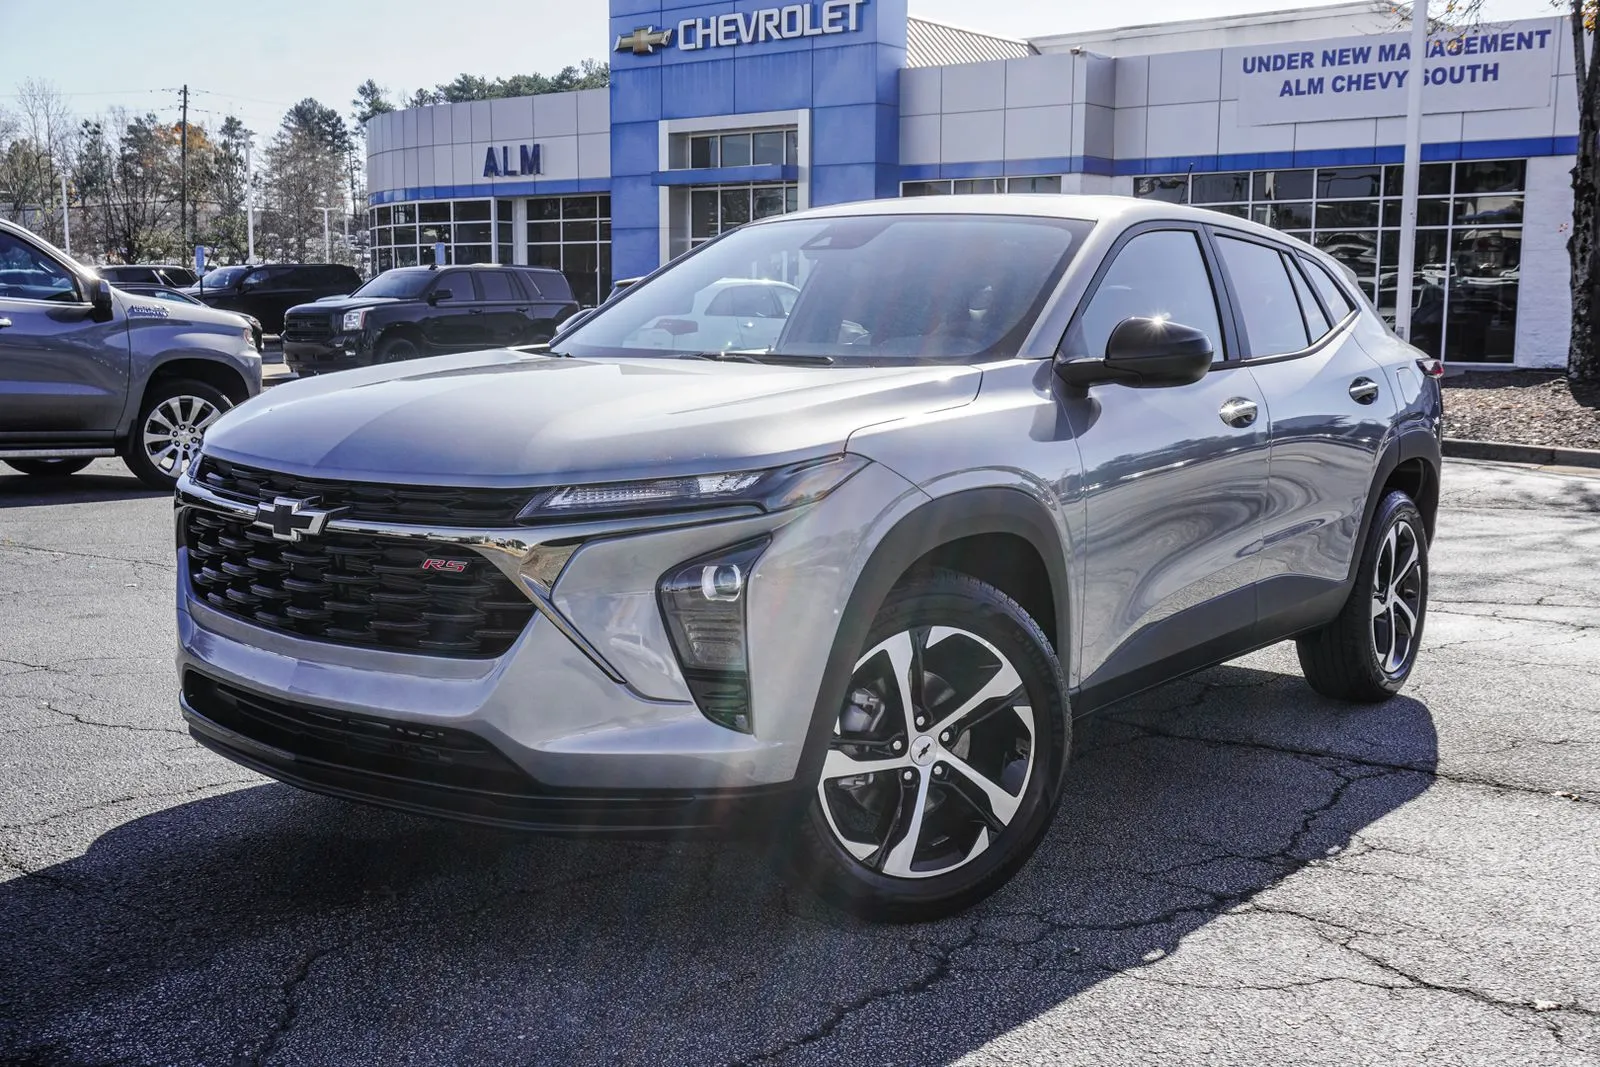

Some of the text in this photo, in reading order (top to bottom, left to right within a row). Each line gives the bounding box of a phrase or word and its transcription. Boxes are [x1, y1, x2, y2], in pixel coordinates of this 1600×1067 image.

[678, 0, 863, 50] CHEVROLET
[1243, 50, 1315, 74] UNDER
[1321, 46, 1371, 67] NEW
[1279, 75, 1324, 97] ALM
[1331, 69, 1410, 93] CHEVY
[483, 143, 542, 177] ALM
[422, 558, 467, 572] RS
